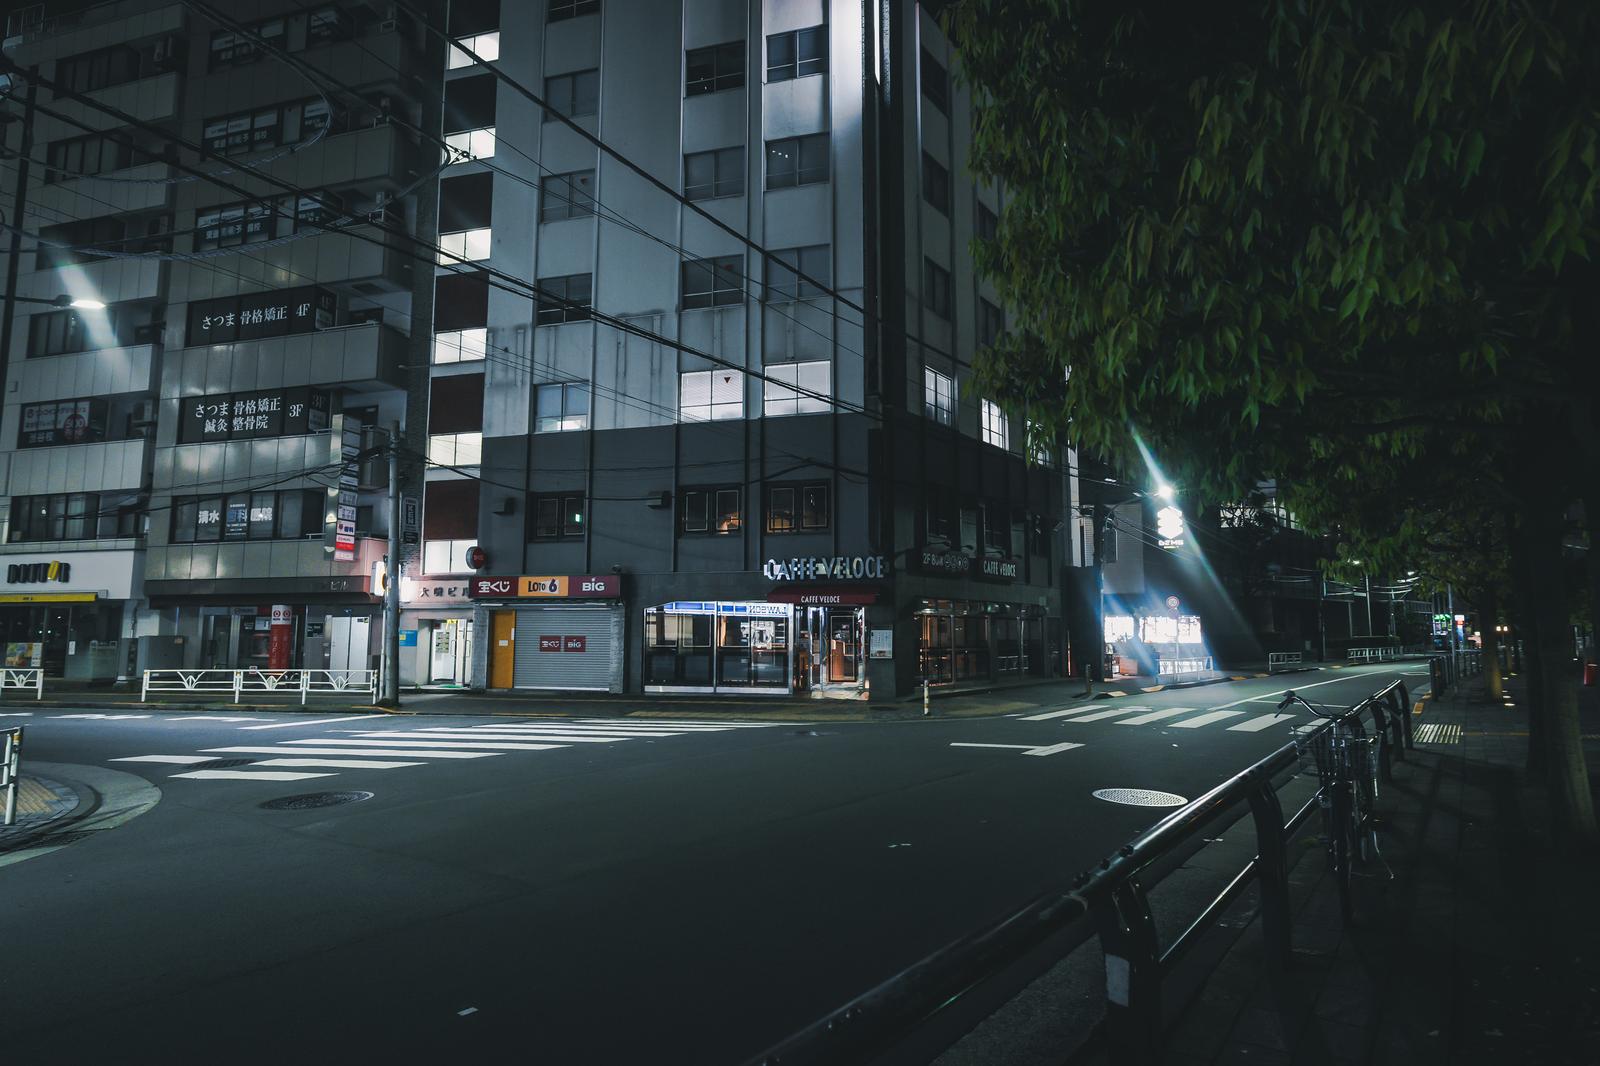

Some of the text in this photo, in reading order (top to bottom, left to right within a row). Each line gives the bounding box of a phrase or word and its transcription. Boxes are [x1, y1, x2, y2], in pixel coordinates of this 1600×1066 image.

[201, 302, 311, 330] さつま 骨格矯正 4F
[195, 396, 304, 418] さつま 骨格矯正 3F
[204, 415, 269, 433] 鍼灸 整骨院
[822, 556, 885, 579] VELOCE
[478, 580, 511, 593] 宝くじ
[548, 578, 558, 593] 6
[819, 595, 840, 603] VELOCE
